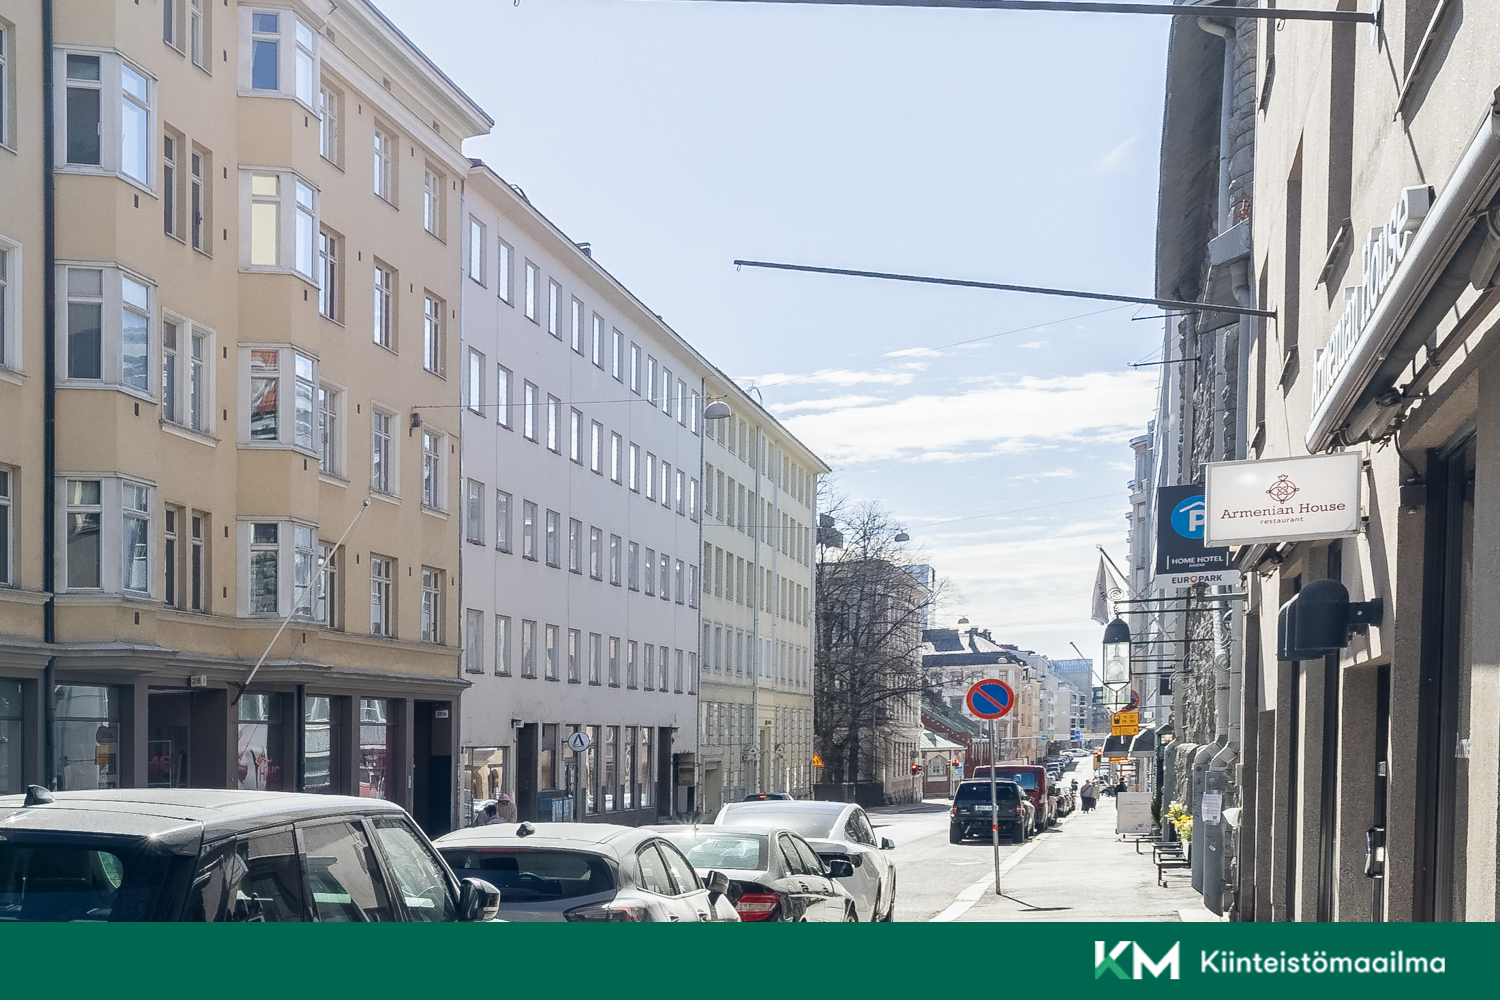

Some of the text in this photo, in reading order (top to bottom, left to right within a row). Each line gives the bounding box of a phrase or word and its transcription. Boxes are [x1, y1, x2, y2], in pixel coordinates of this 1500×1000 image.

[1361, 186, 1413, 331] House
[1220, 502, 1346, 519] Armenian House
[1188, 509, 1205, 532] P
[1260, 516, 1304, 525] restaurant
[1171, 555, 1224, 565] HOME HOTEL
[1171, 574, 1223, 585] EUROPARK
[191, 677, 201, 685] 28
